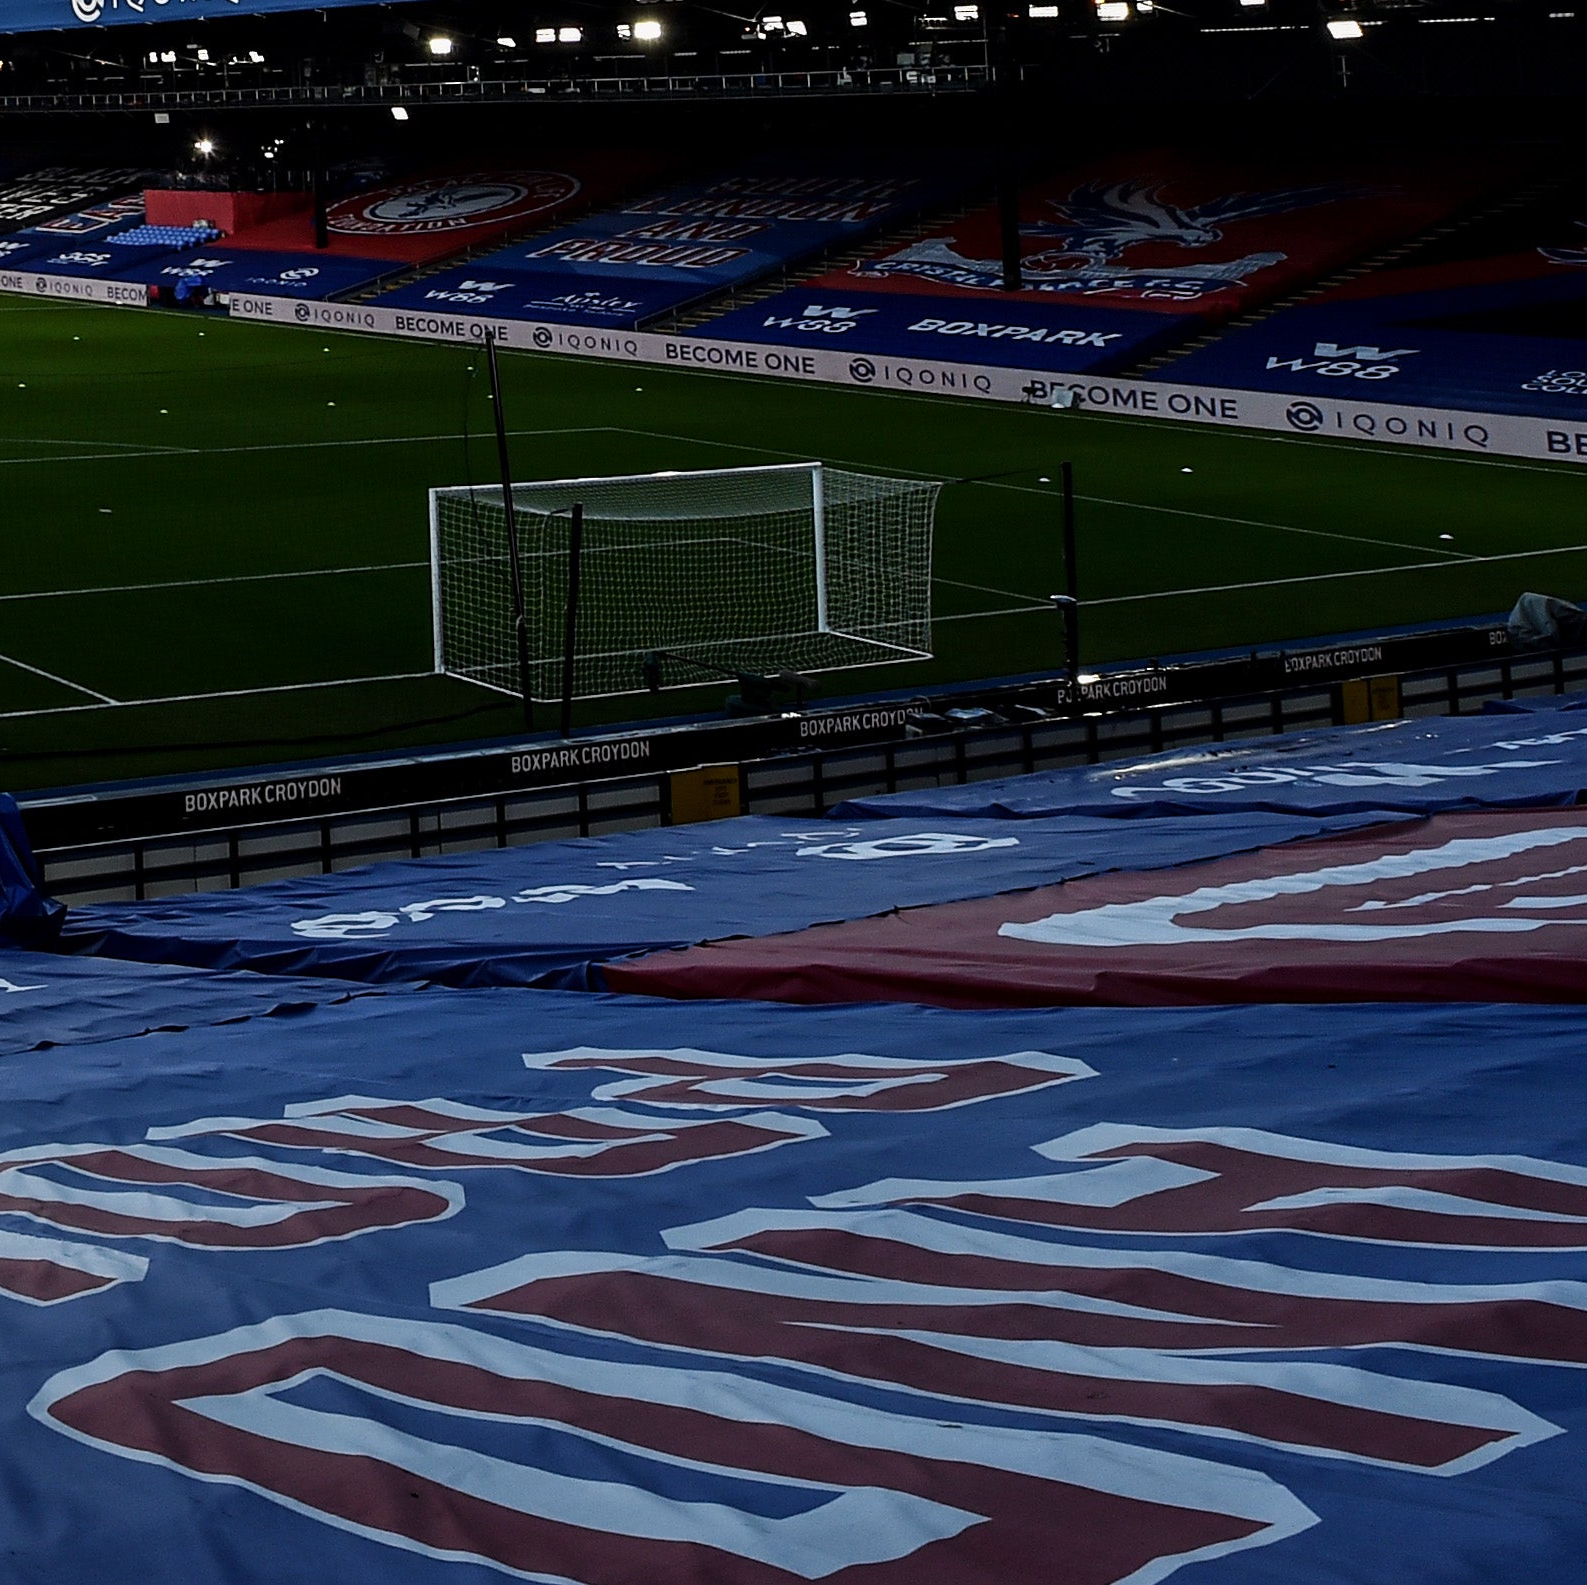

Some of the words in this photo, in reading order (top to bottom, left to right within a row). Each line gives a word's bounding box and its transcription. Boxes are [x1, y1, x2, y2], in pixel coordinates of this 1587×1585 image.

[614, 219, 775, 242] AND
[525, 238, 753, 268] PROUD
[2, 276, 23, 288] ONE
[49, 281, 93, 296] IQONIQ
[243, 301, 273, 315] ONE
[424, 288, 495, 304] W88
[314, 308, 375, 328] IQONIQ
[395, 316, 466, 337] BECOME
[470, 323, 509, 341] ONE
[762, 316, 857, 333] W88
[559, 333, 638, 355] IQONIQ
[907, 318, 1124, 348] BOXPARK
[666, 343, 757, 368] BECOME
[765, 353, 815, 374] ONE
[1265, 356, 1400, 381] W88
[885, 365, 992, 392] IQONIQ
[1167, 394, 1238, 419] ONE
[1337, 411, 1489, 448] IQONIQ
[1284, 654, 1333, 673] BOXPARK
[1333, 647, 1383, 665] CROYDON
[1111, 676, 1167, 698] CROYDON
[799, 714, 861, 738] BOXPARK
[511, 749, 580, 774] BOXPARK
[581, 740, 651, 765] CROYDON
[184, 786, 266, 814] BOXPARK
[267, 777, 343, 807] CROYDON
